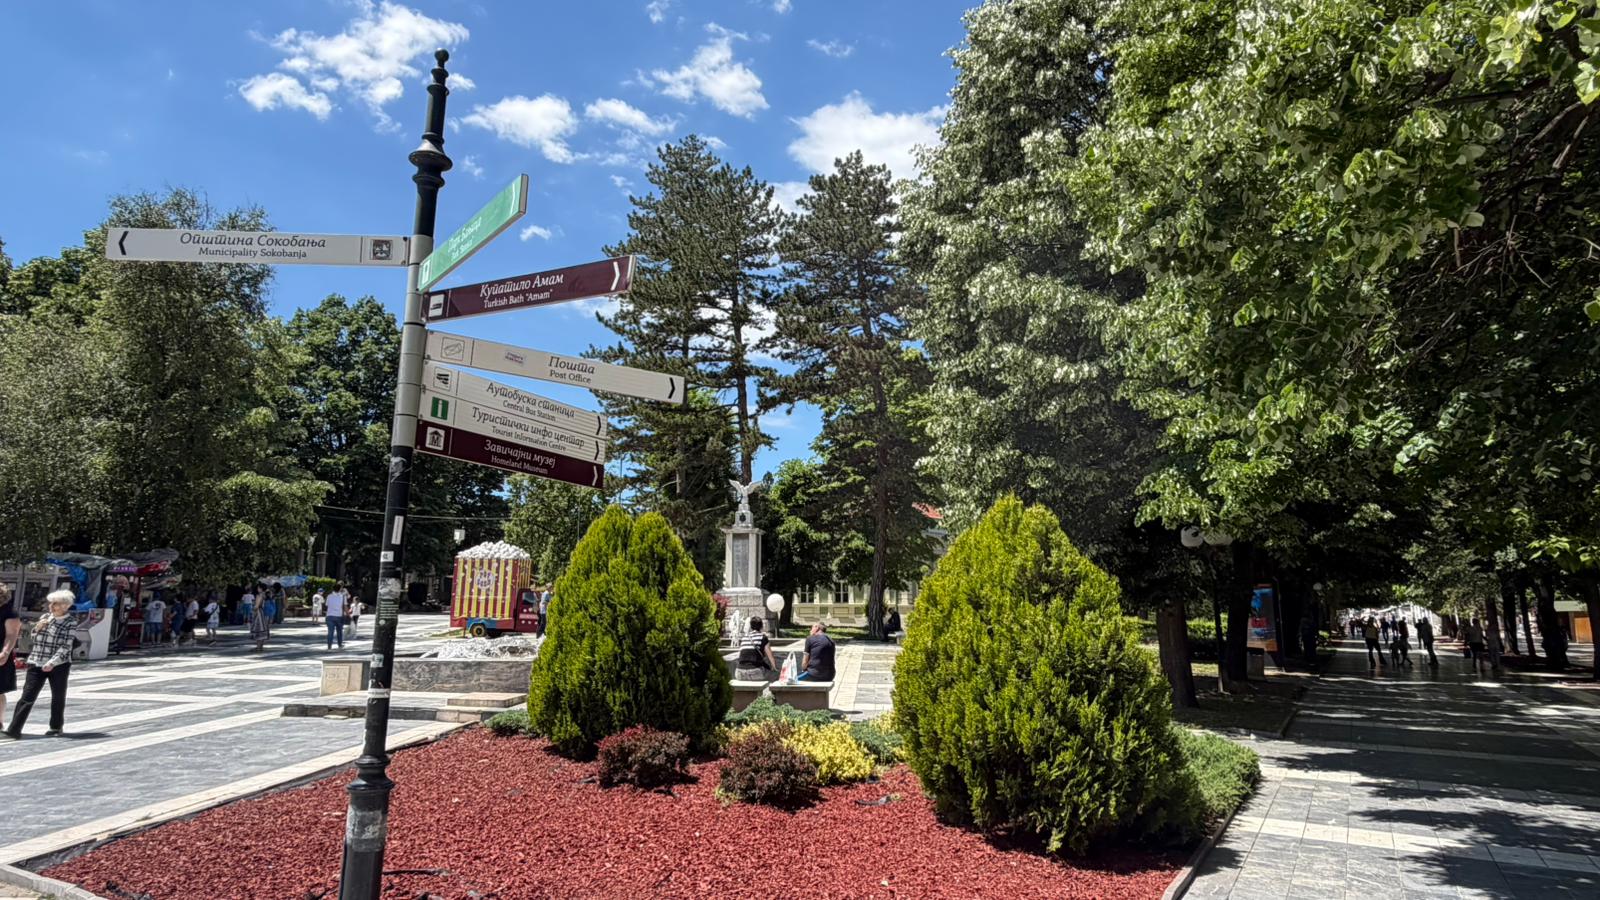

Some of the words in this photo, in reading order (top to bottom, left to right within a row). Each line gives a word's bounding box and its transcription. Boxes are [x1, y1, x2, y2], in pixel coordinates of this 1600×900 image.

[180, 232, 253, 246] Општина
[257, 234, 326, 248] Сокобања
[198, 247, 258, 258] Municipality
[260, 248, 306, 259] Sokobanja
[480, 281, 530, 298] Купатило
[533, 274, 564, 286] Амам
[484, 298, 508, 308] Turkish
[509, 294, 524, 304] Bath
[549, 356, 595, 374] Пошта
[550, 370, 567, 380] Post
[568, 372, 592, 384] Office
[486, 382, 536, 404] Аутобуска
[538, 400, 575, 418] станица
[502, 400, 524, 413] Central
[526, 406, 536, 415] Bus
[536, 409, 556, 422] Station
[472, 407, 529, 432] Туристички
[531, 426, 552, 440] инфо
[554, 432, 585, 448] центар
[492, 426, 512, 438] Tourist
[514, 432, 548, 446] Information
[484, 439, 530, 460] Завичајни
[533, 454, 556, 468] музеј
[491, 456, 522, 469] Homeland
[523, 463, 548, 474] Museum
